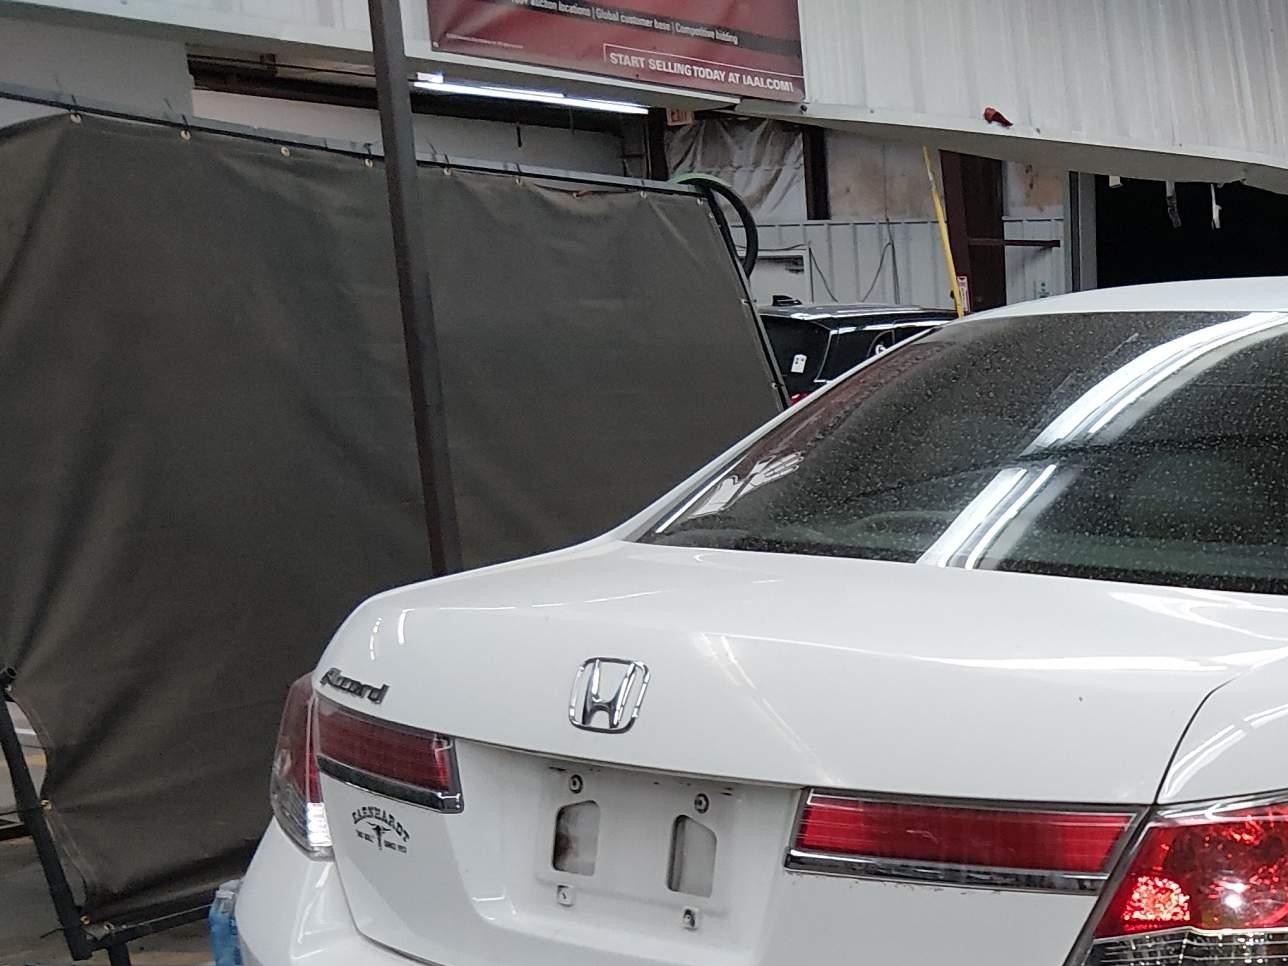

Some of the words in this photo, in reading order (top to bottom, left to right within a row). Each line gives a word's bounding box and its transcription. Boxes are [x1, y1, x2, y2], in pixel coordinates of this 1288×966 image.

[596, 8, 619, 21] Global
[620, 15, 653, 27] customer
[654, 19, 671, 31] base
[716, 30, 739, 45] bidding
[610, 53, 645, 68] START
[649, 58, 692, 76] SELLING
[692, 66, 727, 82] TODAY
[728, 75, 742, 84] AT
[320, 668, 389, 704] Accord
